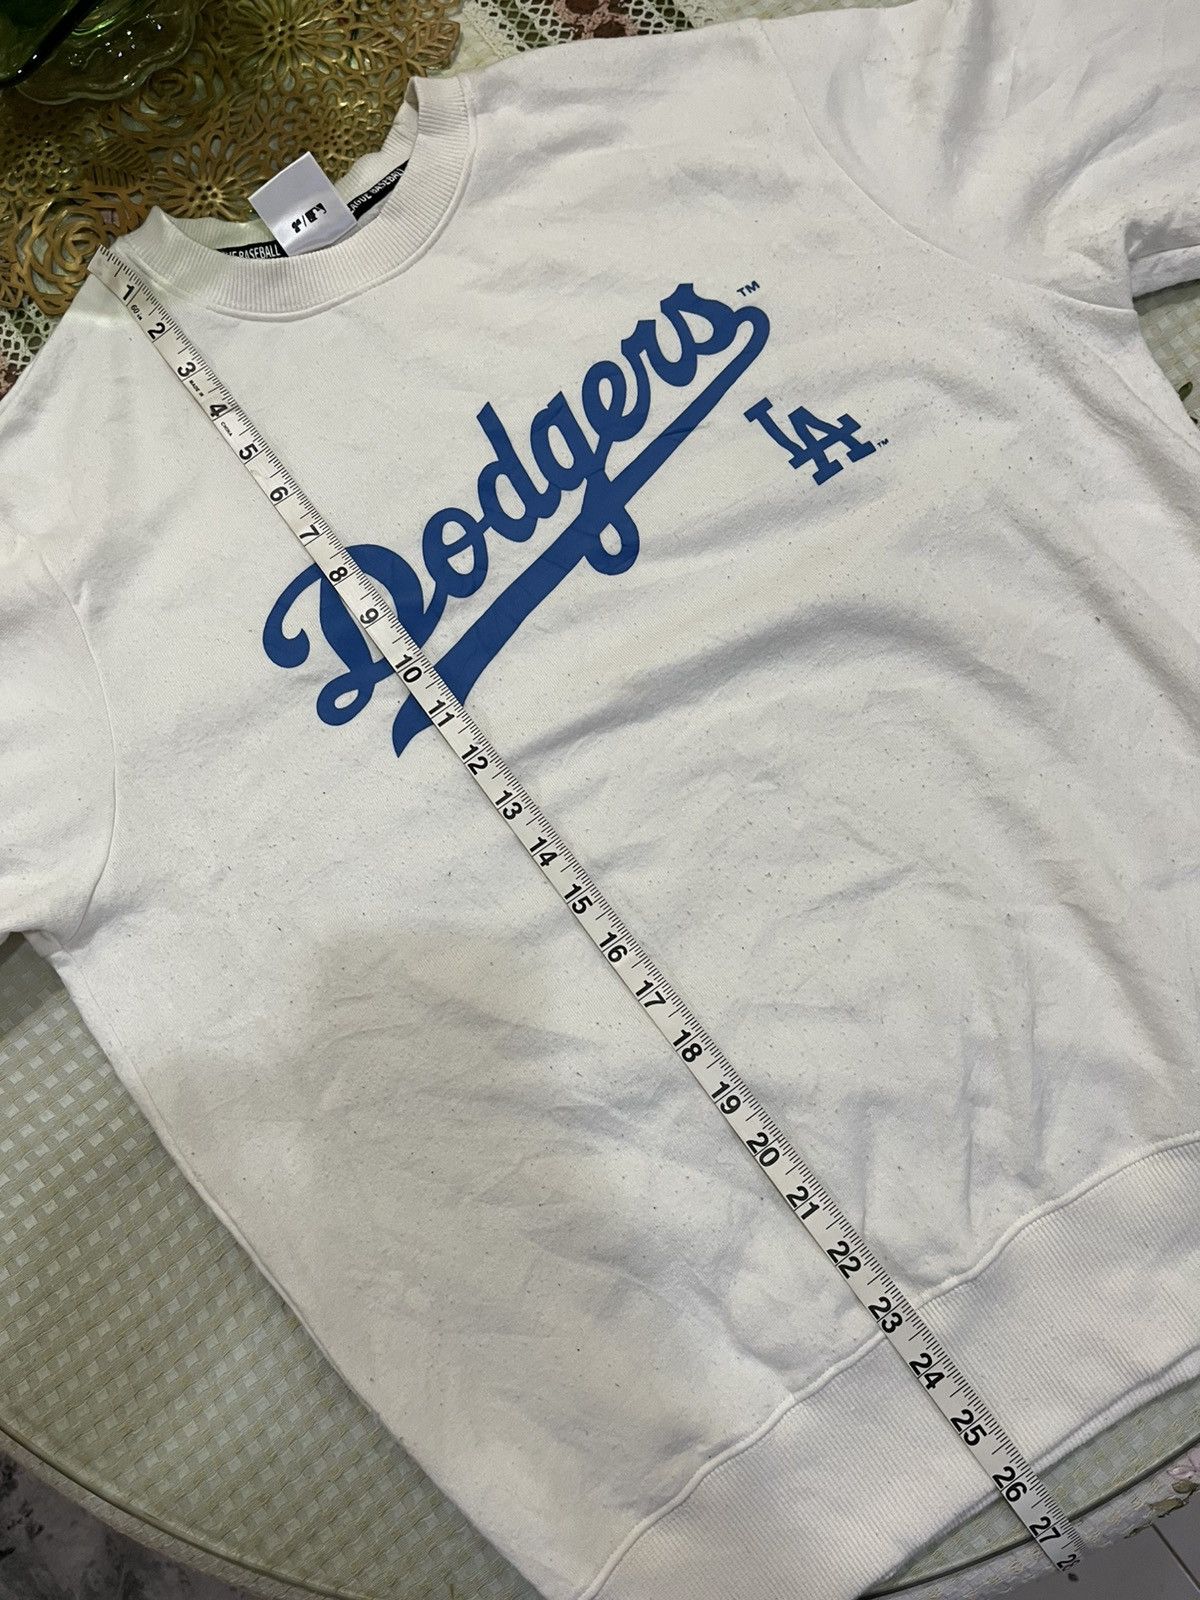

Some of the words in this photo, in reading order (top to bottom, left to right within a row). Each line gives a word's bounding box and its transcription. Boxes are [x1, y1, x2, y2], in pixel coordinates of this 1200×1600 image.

[131, 304, 140, 314] 60
[743, 396, 877, 486] LA
[263, 283, 770, 758] Dodgers
[122, 284, 135, 301] 1
[147, 322, 166, 339] 2
[177, 361, 196, 377] 3
[210, 404, 228, 417] 4
[239, 443, 259, 460] 5
[269, 486, 289, 502] 6
[299, 524, 320, 540] 7
[329, 566, 348, 582] 8
[360, 608, 379, 625] 9
[395, 654, 422, 683] 10
[428, 700, 455, 728] 11
[461, 744, 489, 775] 12
[495, 790, 523, 820] 13
[530, 836, 558, 867] 14
[564, 883, 593, 914] 15
[599, 931, 628, 963] 16
[635, 979, 666, 1008] 17
[672, 1029, 702, 1063] 18
[711, 1081, 741, 1115] 19
[746, 1131, 780, 1167] 20
[785, 1185, 820, 1220] 21
[826, 1240, 862, 1279] 22
[867, 1296, 903, 1334] 23
[908, 1352, 945, 1390] 24
[950, 1408, 987, 1446] 25
[992, 1466, 1028, 1502] 26
[1029, 1516, 1061, 1543] 27
